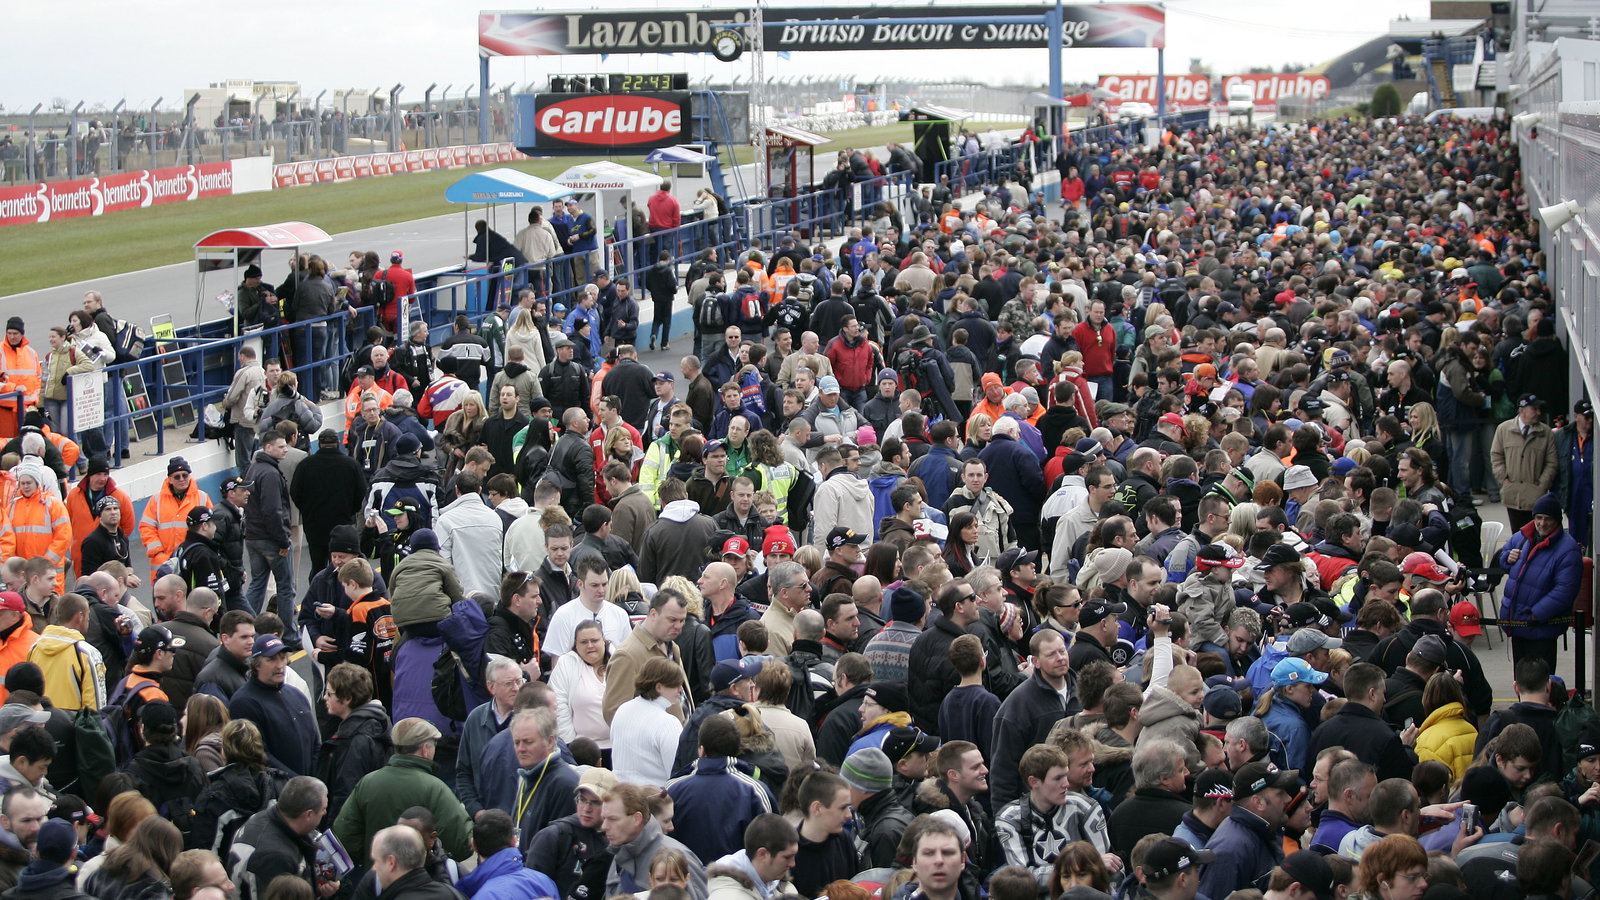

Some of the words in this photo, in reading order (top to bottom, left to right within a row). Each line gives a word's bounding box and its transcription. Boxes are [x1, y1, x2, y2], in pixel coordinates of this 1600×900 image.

[983, 19, 1090, 48] Sausge
[541, 106, 682, 134] Carlube
[51, 187, 92, 213] bennetts
[103, 179, 141, 206] bennetts
[153, 172, 187, 198] bennetts
[198, 168, 232, 192] bennetts
